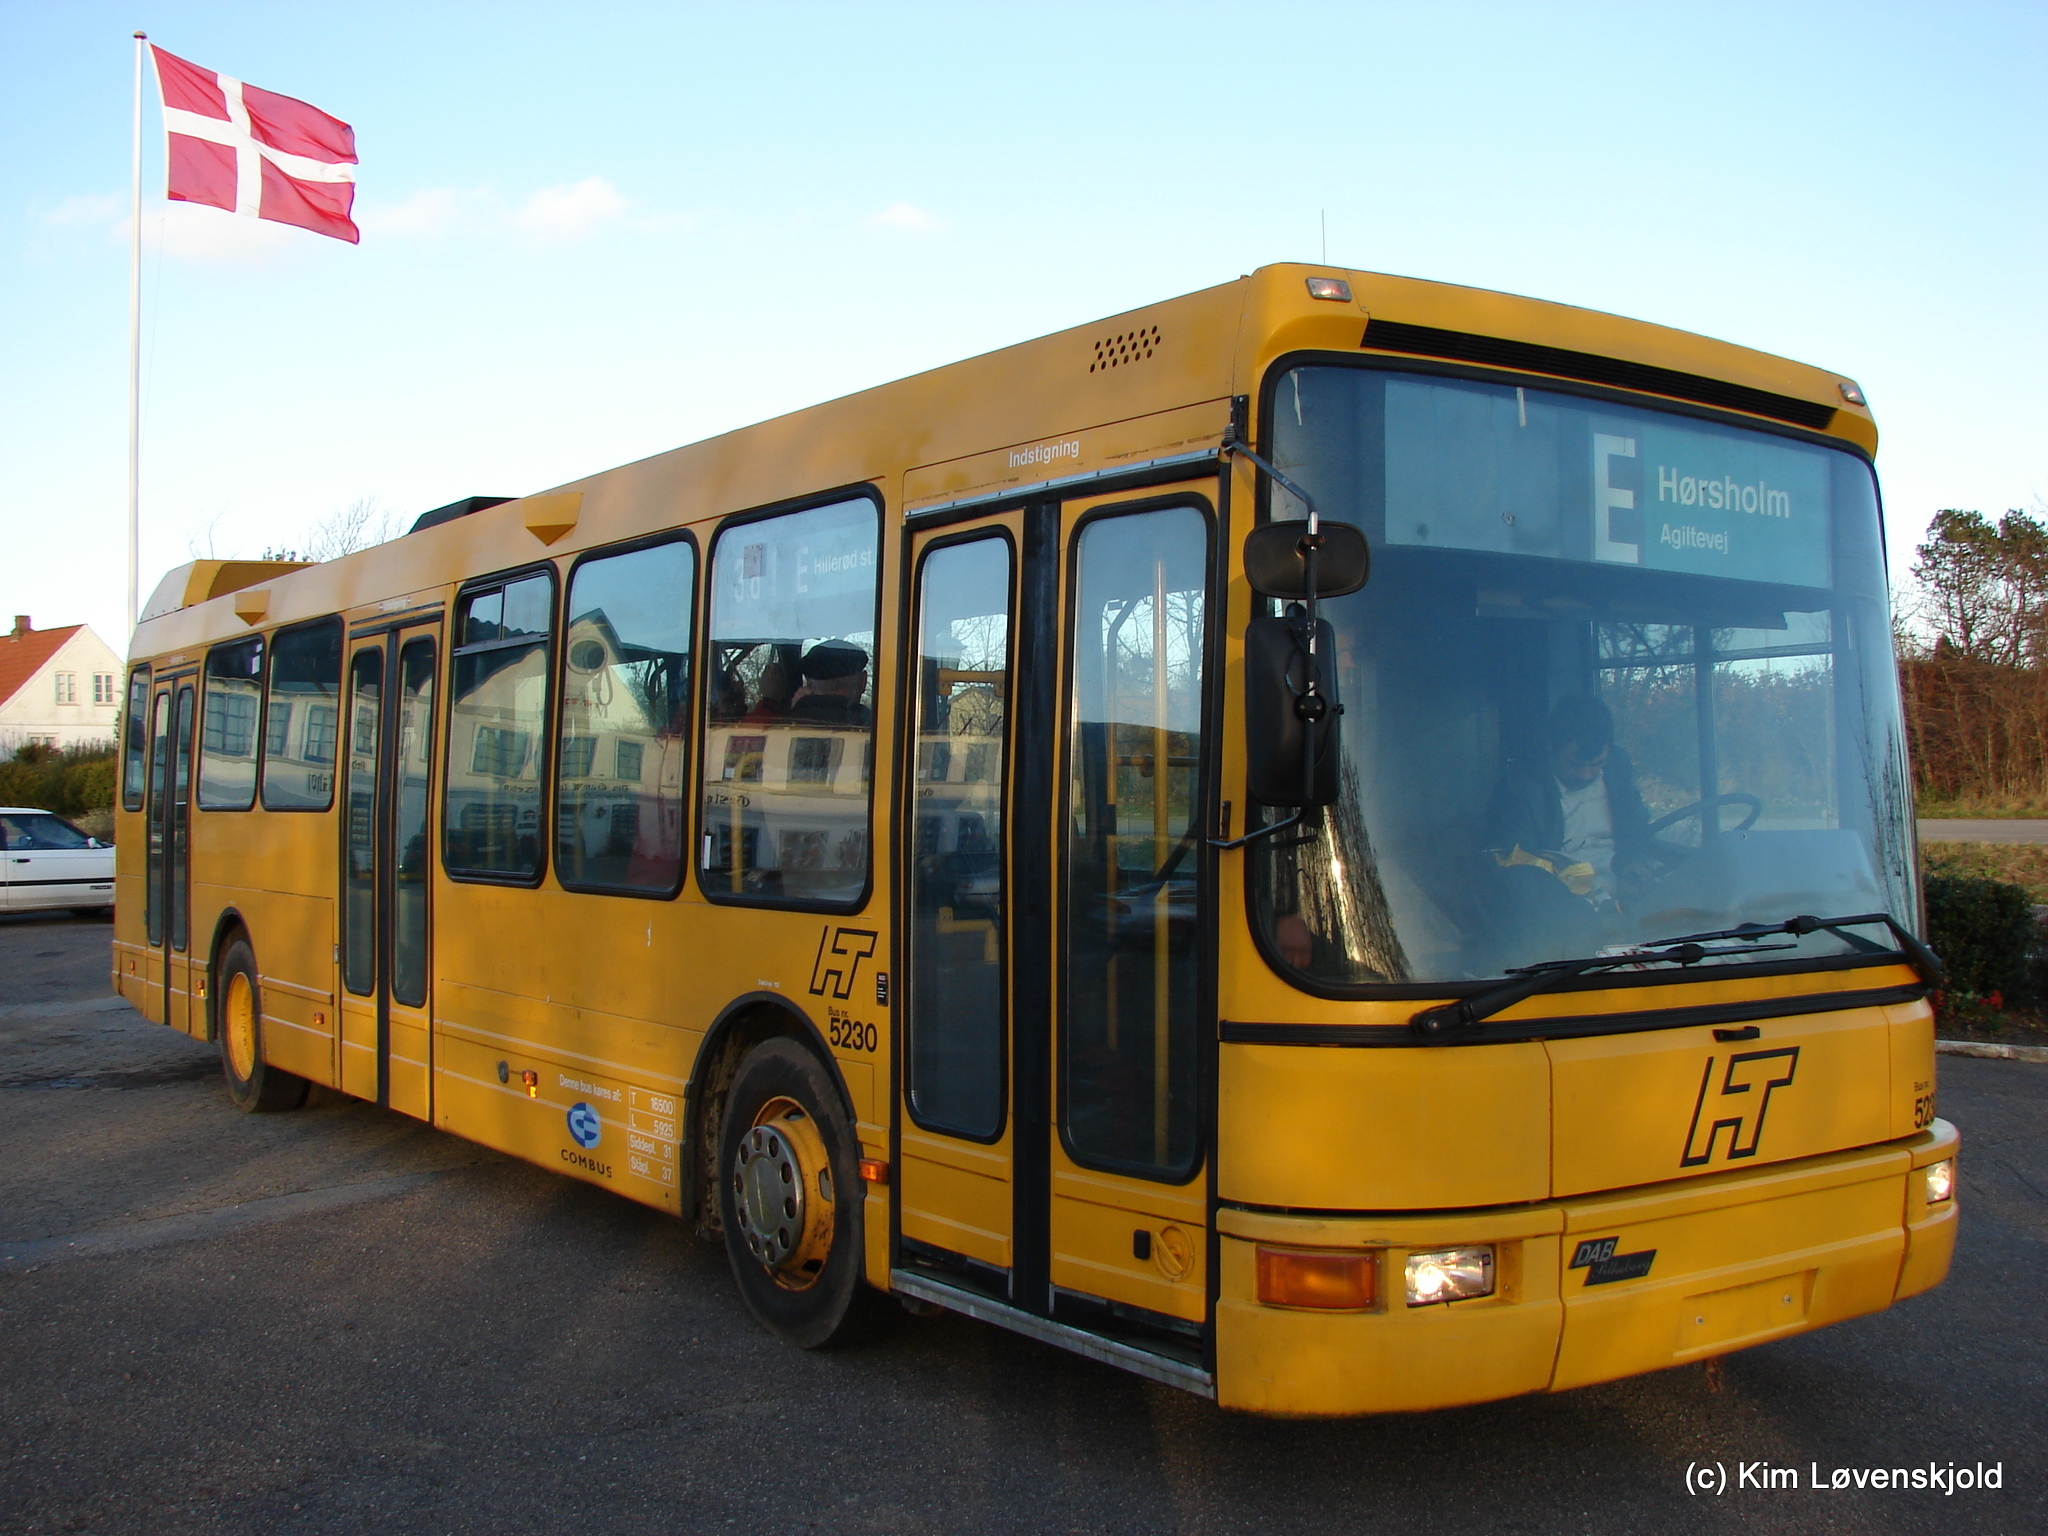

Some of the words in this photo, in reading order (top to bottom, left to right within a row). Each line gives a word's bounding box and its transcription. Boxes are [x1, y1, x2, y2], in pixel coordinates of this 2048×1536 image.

[1009, 440, 1080, 468] Indstigning
[1594, 433, 1638, 563] E
[1658, 465, 1790, 518] Hørsholm
[1660, 523, 1728, 555] Agiltevej
[797, 546, 809, 594] E
[814, 552, 858, 575] Hillerød
[860, 547, 876, 566] st.
[828, 1006, 840, 1017] Bus
[829, 1017, 878, 1053] 5230
[559, 1074, 579, 1090] Denne
[580, 1080, 592, 1094] bus
[631, 1092, 637, 1105] T
[650, 1097, 674, 1115] 16500
[631, 1113, 637, 1127] L
[653, 1120, 674, 1138] 5925
[629, 1134, 657, 1154] Siddepl.
[663, 1144, 672, 1159] 31
[561, 1149, 612, 1178] COMBUS
[630, 1156, 651, 1174] Ståpl.
[662, 1166, 672, 1181] 37
[1573, 1240, 1615, 1266] DAB
